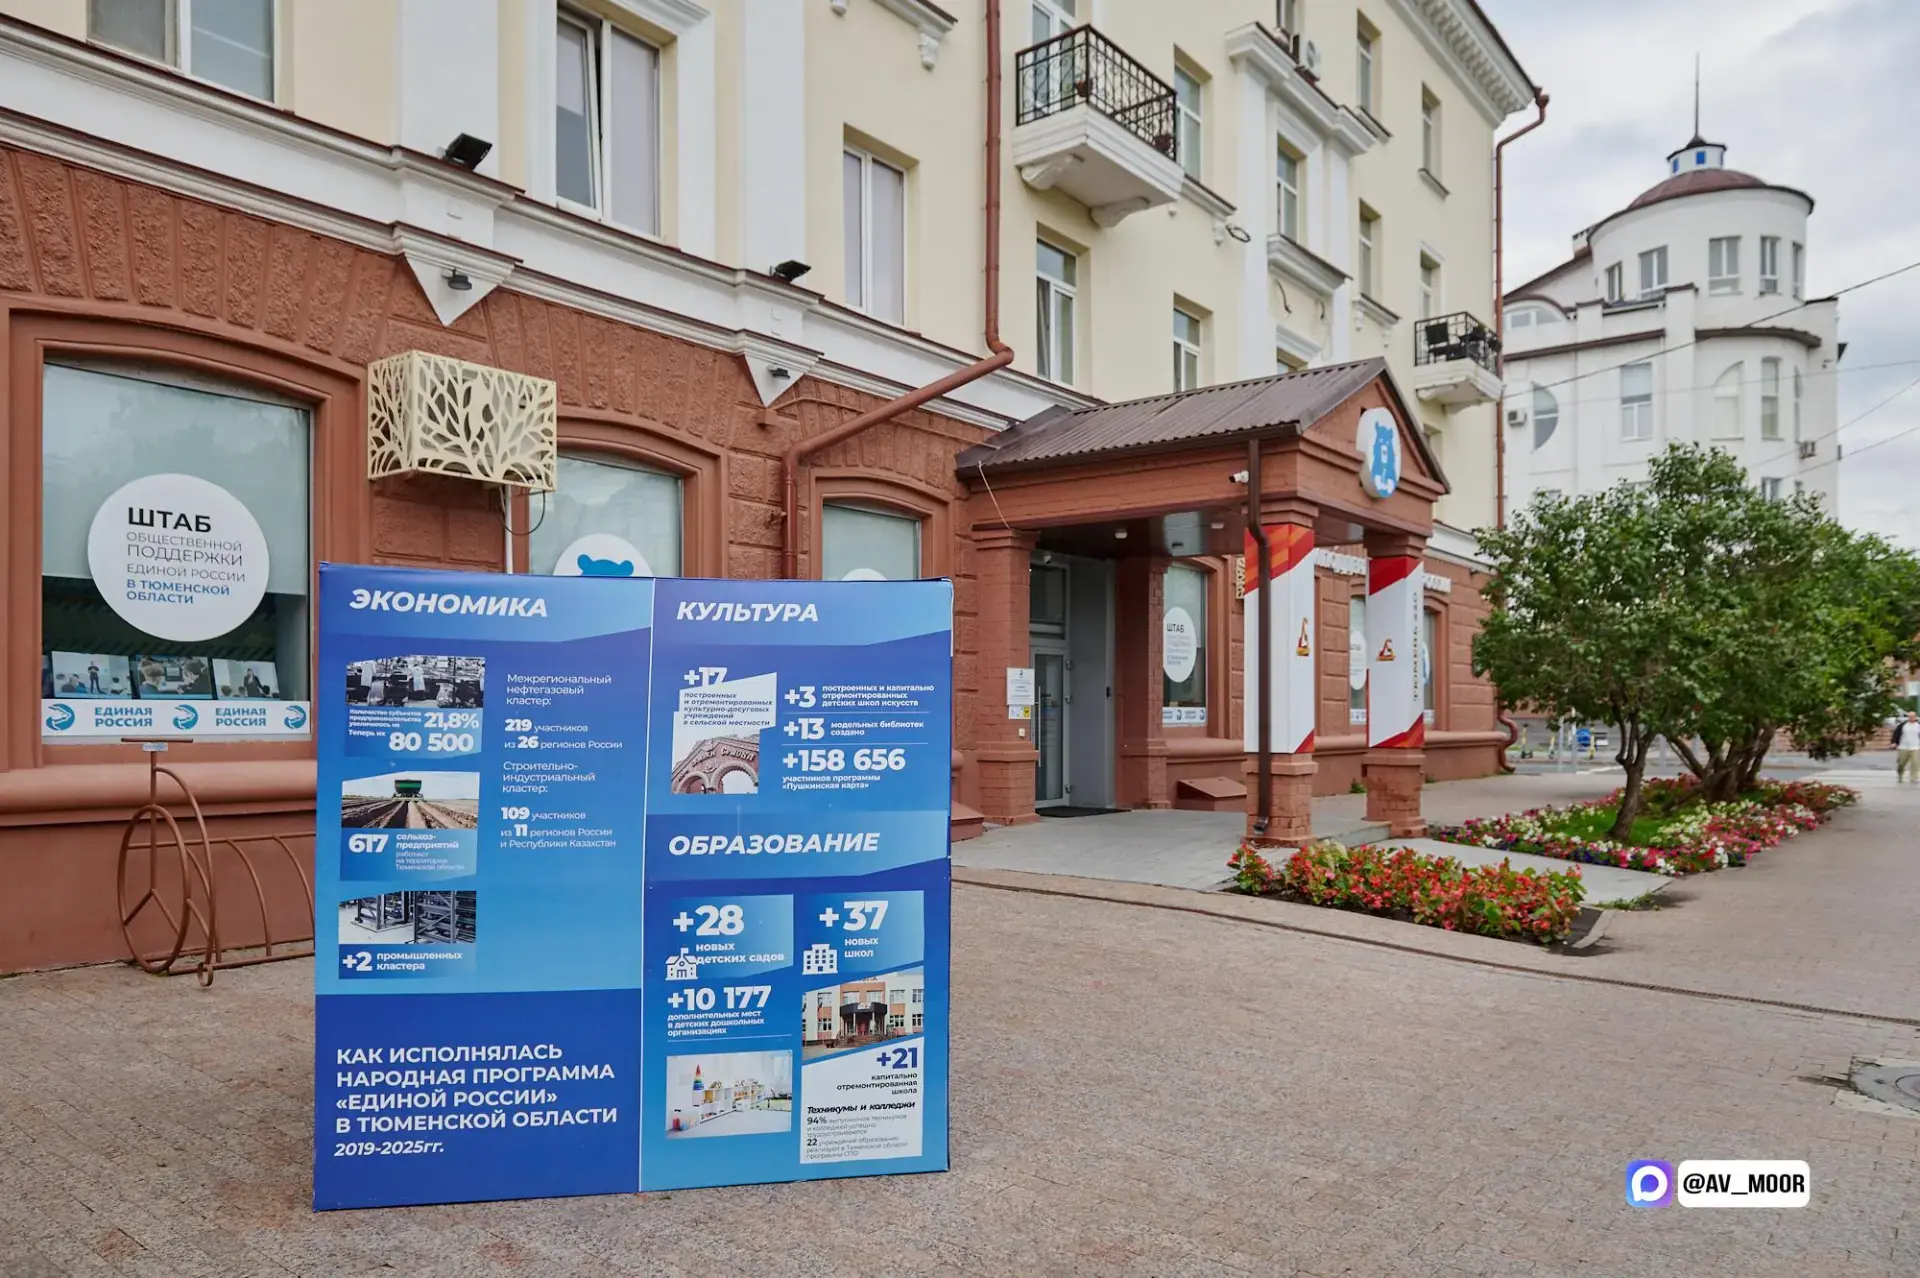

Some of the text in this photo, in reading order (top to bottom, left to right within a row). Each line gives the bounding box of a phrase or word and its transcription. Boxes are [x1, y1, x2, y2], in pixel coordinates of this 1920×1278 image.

[127, 506, 212, 533] ШТАБ
[126, 532, 242, 551] ОБЩЕСТВЕННОЙ
[127, 545, 243, 566] ПОДДЕРЖКИ
[127, 563, 245, 583] ЕДИНОЙ РОССИИ
[127, 579, 230, 595] В ТЮМЕНСКОЙ
[126, 591, 193, 604] ОБЛАСТИ
[349, 588, 548, 618] ЭКОНОМИКА
[677, 601, 819, 622] КУЛЬТУРА
[1166, 623, 1184, 633] ШТАБ
[507, 673, 612, 685] Межрегиональный
[684, 667, 728, 687] +17
[506, 685, 584, 696] нефтегазовый
[784, 685, 816, 708] +3
[822, 685, 878, 693] построенных
[506, 696, 552, 707] кластер:
[95, 707, 152, 716] ЕДИНАЯ
[215, 707, 266, 716] ЕДИНАЯ
[95, 717, 153, 727] РОССИЯ
[215, 717, 266, 727] РОССИЯ
[424, 712, 479, 731] 21,8%
[505, 718, 588, 734] 219 участников
[783, 718, 825, 740] +13
[831, 720, 924, 729] модельных библиотек
[389, 732, 421, 751] 80
[427, 733, 474, 752] 500
[505, 736, 623, 751] из 26 регионов России
[503, 761, 578, 771] Строительно-
[782, 749, 845, 772] +158
[853, 748, 906, 771] 656
[503, 772, 595, 783] индустриальный
[782, 775, 831, 783] участников
[502, 784, 548, 794] кластер:
[782, 782, 839, 791] «Пушкинская
[501, 806, 586, 821] 109 участников
[501, 824, 612, 839] из 11 регионов России
[348, 833, 389, 853] 617
[396, 841, 459, 850] предприятий
[507, 839, 567, 850] Республики
[569, 838, 616, 847] Казахстан
[668, 832, 880, 856] ОБРАЗОВАНИЕ
[673, 904, 744, 936] +28
[819, 900, 889, 932] +37
[696, 942, 735, 952] новых
[844, 937, 879, 946] новых
[696, 952, 785, 965] детских садов
[844, 949, 874, 958] школ
[342, 951, 463, 972] +2 промышленных
[377, 961, 425, 972] кластера
[667, 985, 771, 1010] +10 177
[667, 1011, 739, 1021] дополнительных
[675, 1021, 709, 1029] детских
[711, 1019, 764, 1027] дошкольных
[668, 1028, 727, 1037] организациях
[337, 1044, 562, 1065] КАК ИСПОЛНЯЛАСЬ
[877, 1047, 918, 1069] +21
[336, 1064, 615, 1088] НАРОДНАЯ ПРОГРАММА
[837, 1081, 917, 1091] отремонтированная
[336, 1088, 557, 1112] «ЕДИНОЙ РОССИИ»
[807, 1105, 857, 1114] Техникумы
[869, 1101, 915, 1111] колледжи
[336, 1108, 617, 1133] В ТЮМЕНСКОЙ ОБЛАСТИ
[334, 1140, 445, 1156] 2019-2025гг.
